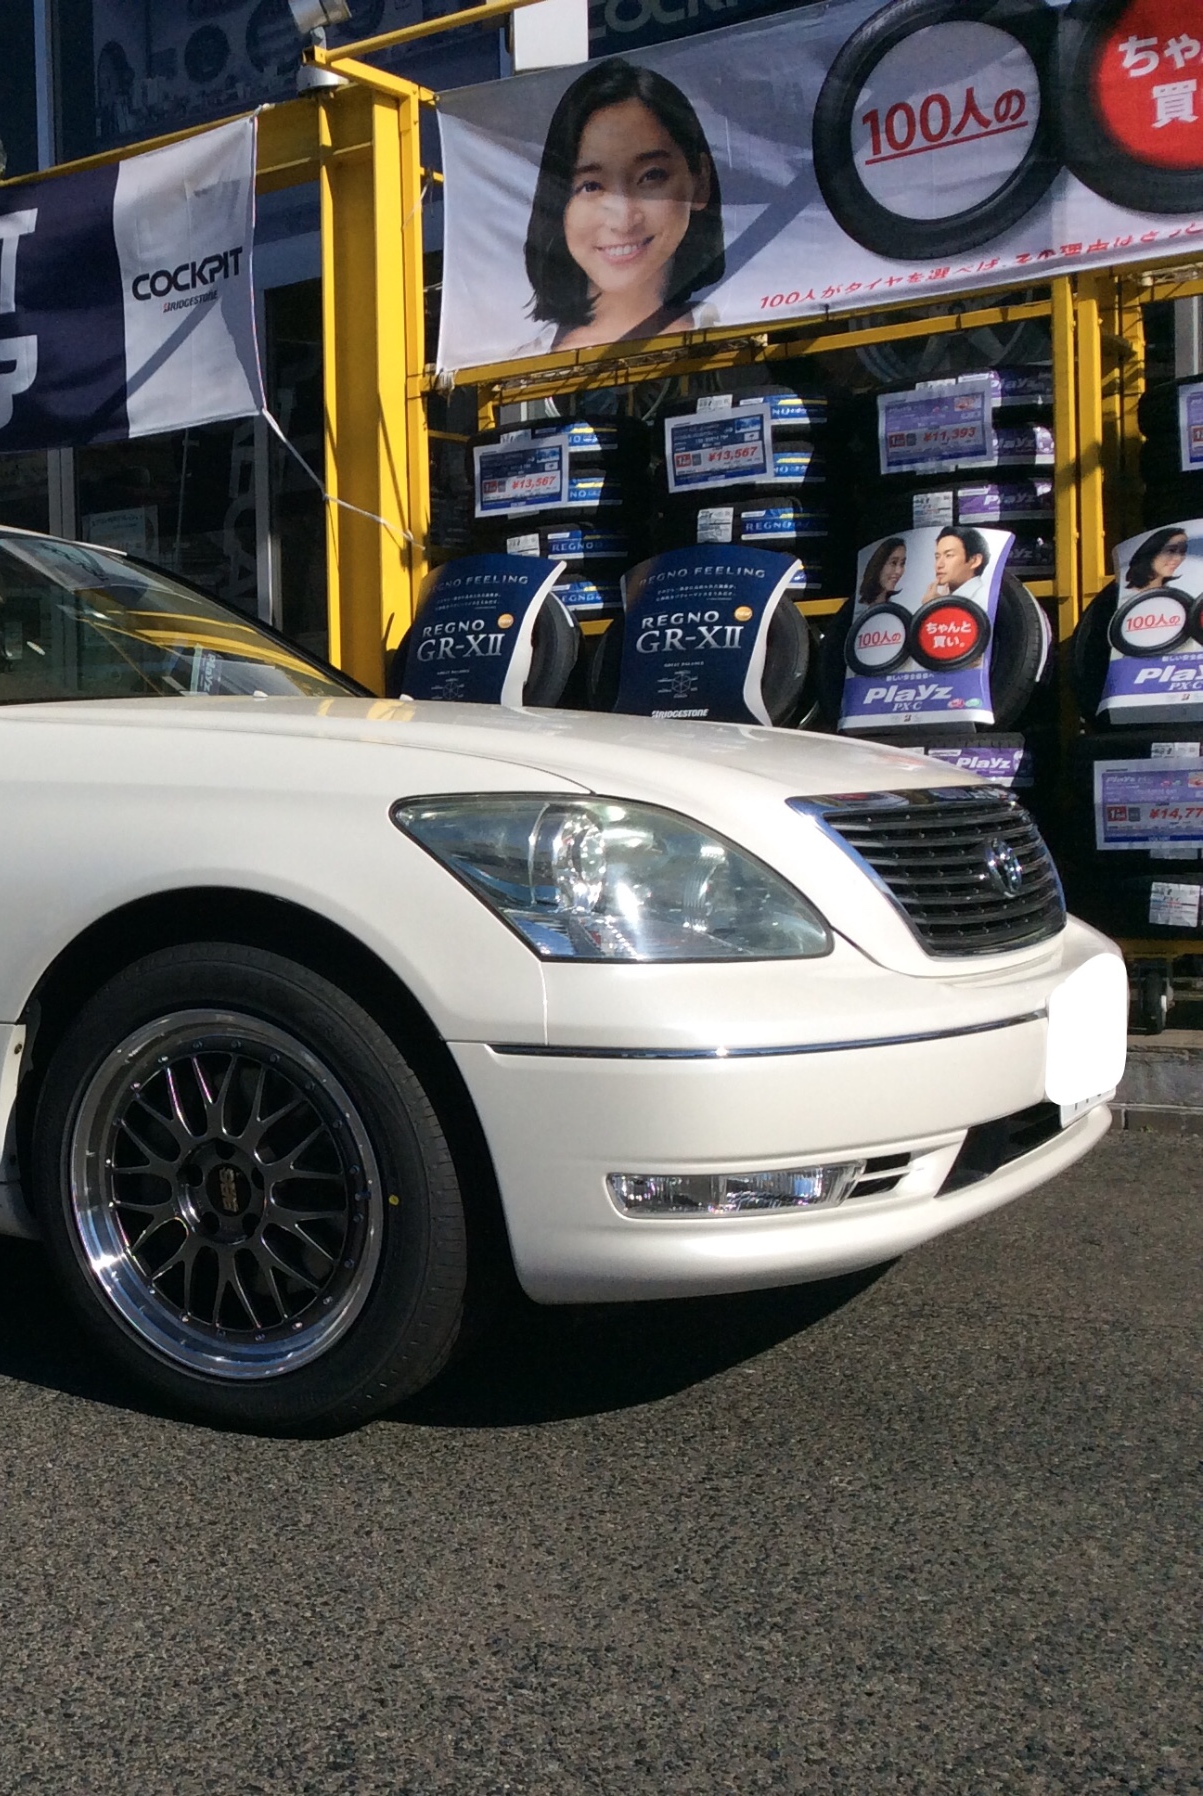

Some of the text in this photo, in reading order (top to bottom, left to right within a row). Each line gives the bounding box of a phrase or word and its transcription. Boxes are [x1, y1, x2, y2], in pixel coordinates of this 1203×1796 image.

[1119, 33, 1203, 77] ちゃ
[861, 87, 1027, 156] 100人の
[131, 246, 243, 301] COCKPIT
[162, 289, 218, 313] BRIDGESTONE
[923, 427, 977, 442] ¥11,393
[708, 446, 758, 462] ¥13,567
[511, 476, 557, 490] ¥13,567
[745, 520, 792, 531] REGNO
[551, 542, 594, 552] REGNO
[465, 575, 529, 586] FEELING
[693, 566, 766, 580] FEELING
[561, 594, 594, 604] EGNO
[641, 610, 720, 629] REGNO
[1126, 613, 1181, 631] 100人の
[422, 619, 485, 638] REGNO
[925, 621, 972, 634] ちゃんと
[858, 632, 902, 647] 100人の
[863, 684, 954, 704] Playz
[956, 756, 1012, 769] Playz
